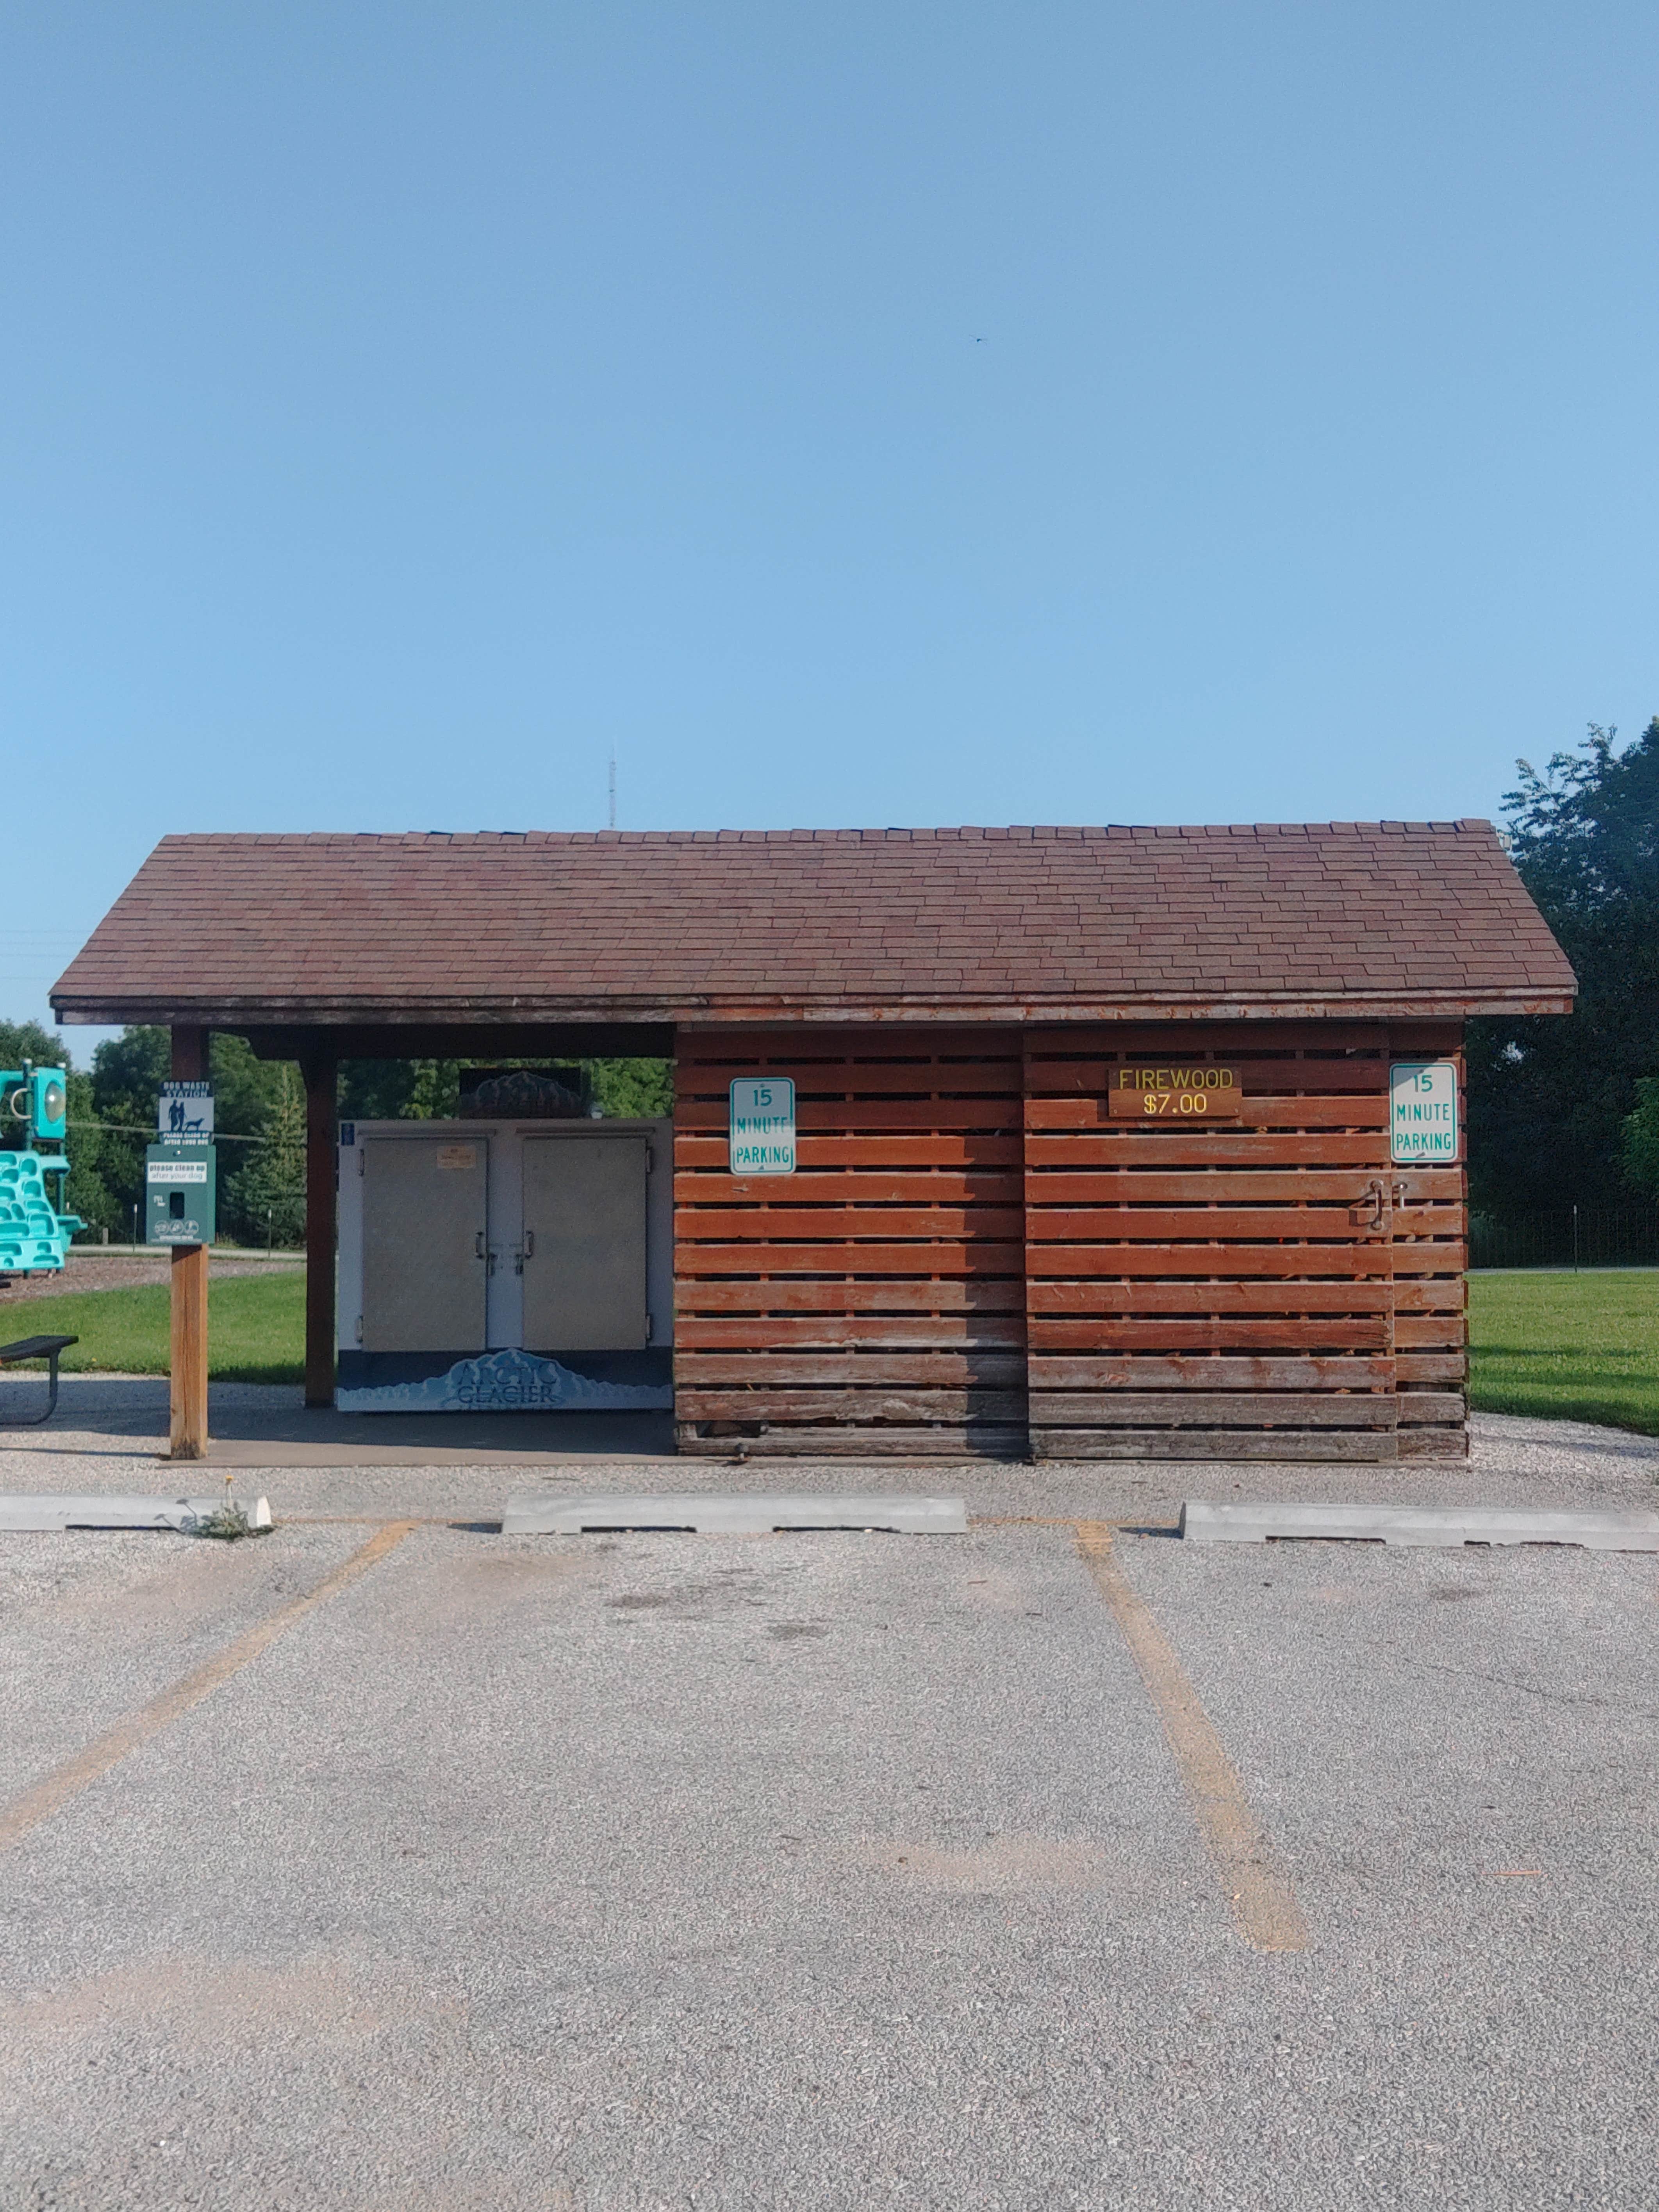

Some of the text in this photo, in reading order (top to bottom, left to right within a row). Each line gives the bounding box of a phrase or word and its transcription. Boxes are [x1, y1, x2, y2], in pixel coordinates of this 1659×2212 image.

[163, 1081, 210, 1090] DOG WASTE
[1120, 1069, 1233, 1090] FIREWOOD
[1413, 1075, 1433, 1092] 15
[753, 1089, 772, 1106] 15
[1144, 1094, 1207, 1114] $7.00
[1397, 1104, 1450, 1121] MINUTE
[737, 1117, 788, 1134] MINUTE
[1396, 1133, 1451, 1151] PARKING
[737, 1146, 789, 1163] PARKING
[458, 1362, 557, 1384] ARCTIC
[458, 1386, 556, 1403] GLACIER
